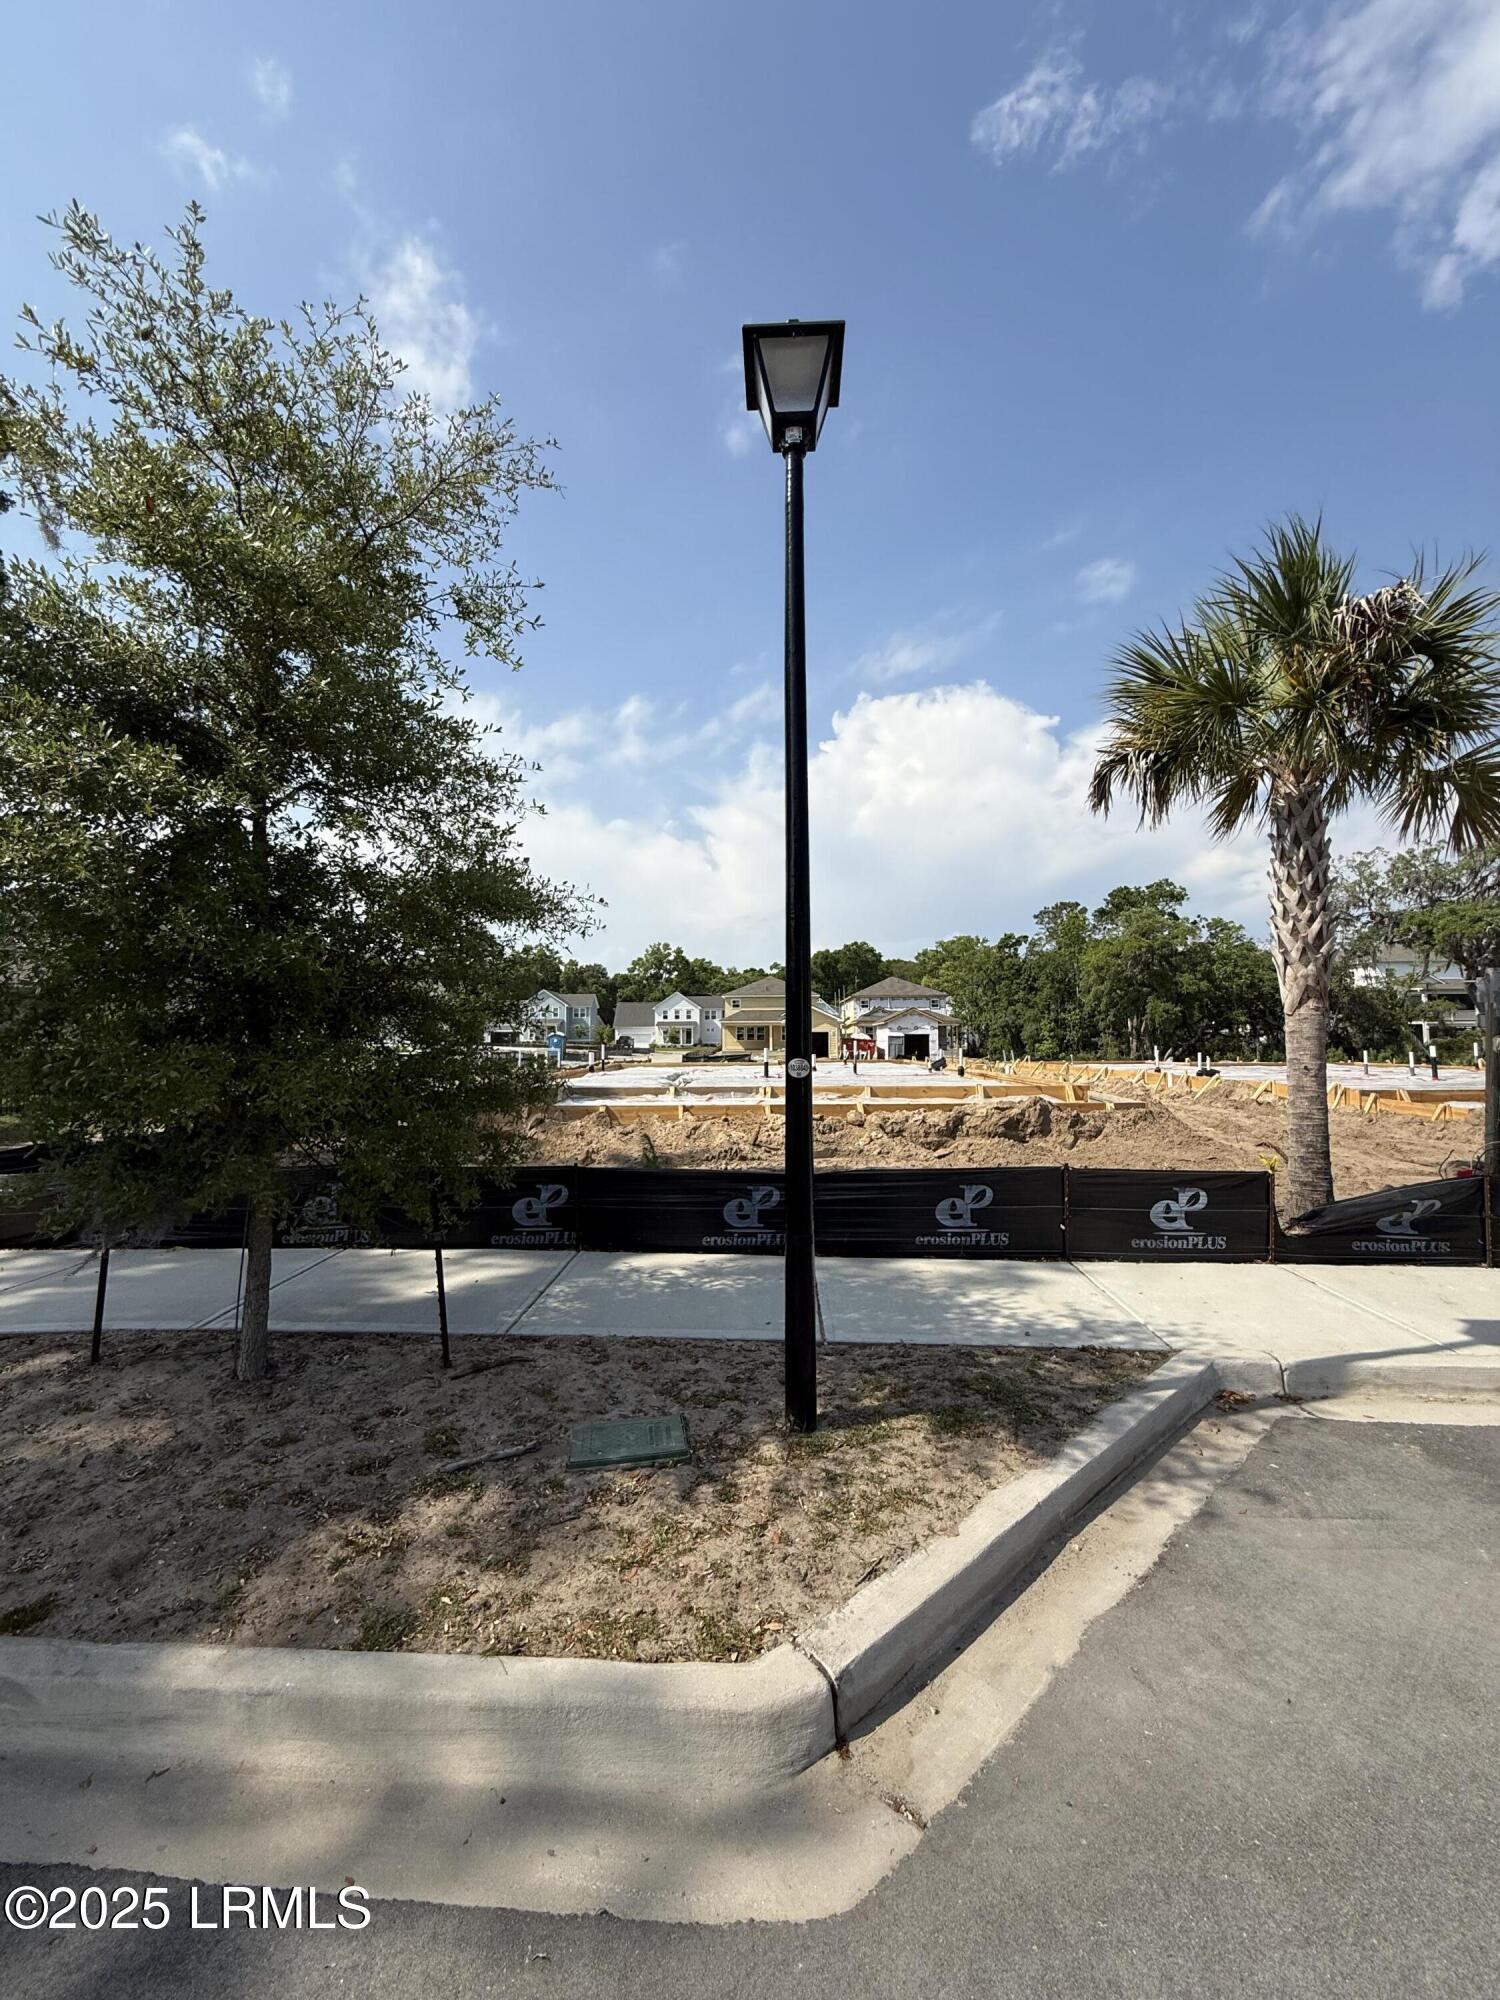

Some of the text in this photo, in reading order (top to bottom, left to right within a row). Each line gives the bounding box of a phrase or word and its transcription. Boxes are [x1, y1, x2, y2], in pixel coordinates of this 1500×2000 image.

[701, 1233, 786, 1247] erosionPLU
[915, 1232, 1010, 1247] erosionPLUS
[1131, 1235, 1227, 1250] erosionPLUS
[1351, 1239, 1451, 1253] erosionPLUS
